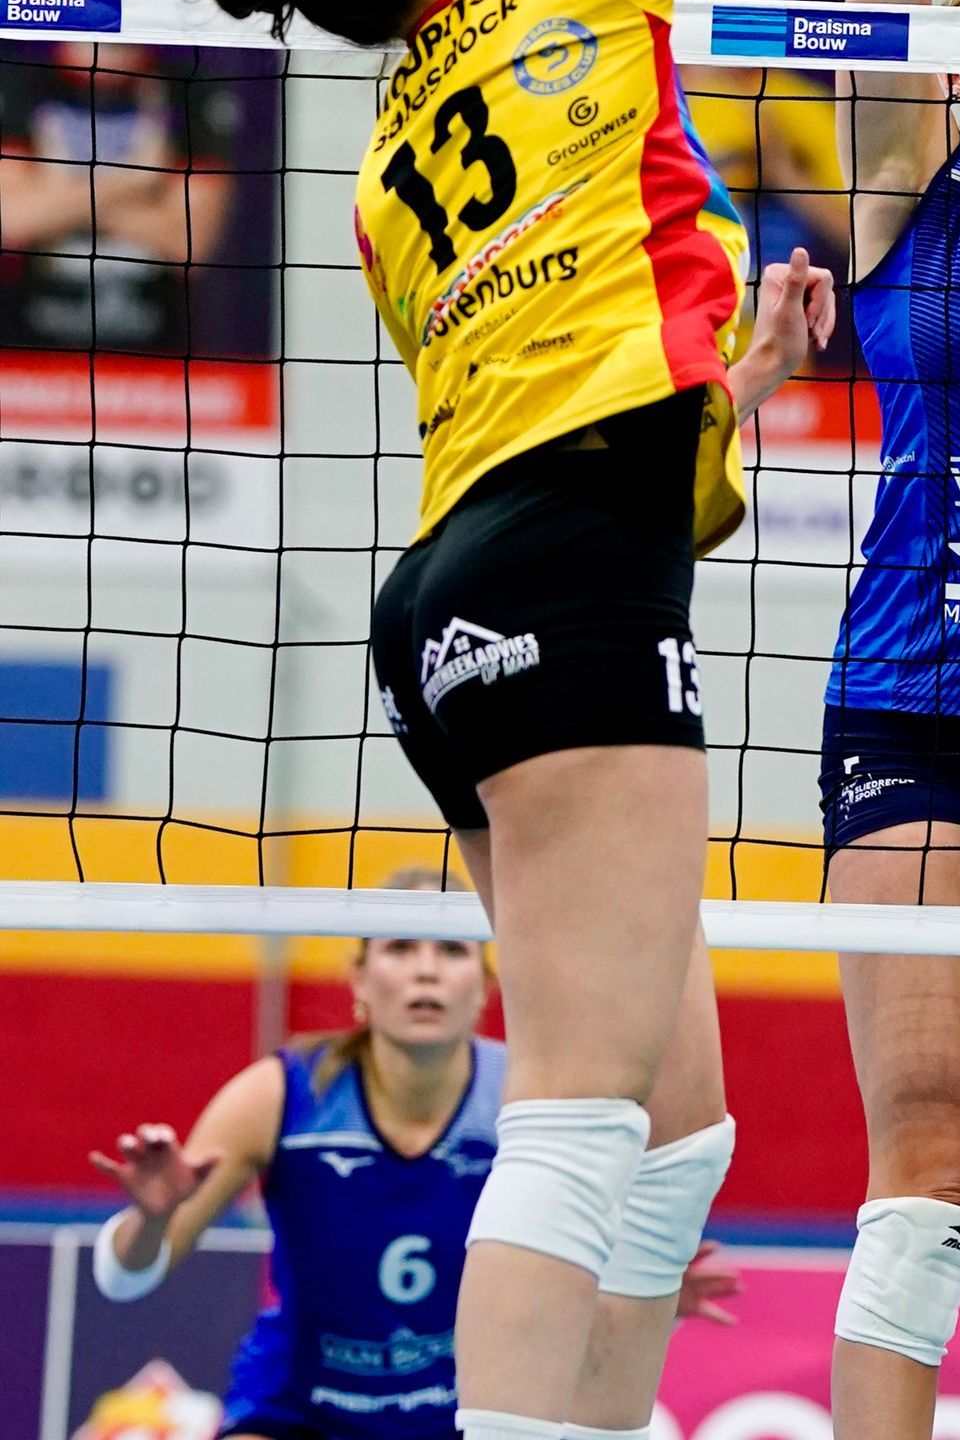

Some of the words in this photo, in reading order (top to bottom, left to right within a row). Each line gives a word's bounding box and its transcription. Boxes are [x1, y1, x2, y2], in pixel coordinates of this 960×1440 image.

[7, 5, 61, 23] Bouw
[793, 18, 872, 36] Draisma
[793, 34, 847, 51] Bouw
[546, 106, 638, 167] Groupwise
[380, 85, 517, 275] 13
[424, 245, 579, 347] renburg
[657, 637, 703, 716] 13
[854, 787, 882, 803] SPORT
[377, 1233, 437, 1305] 6
